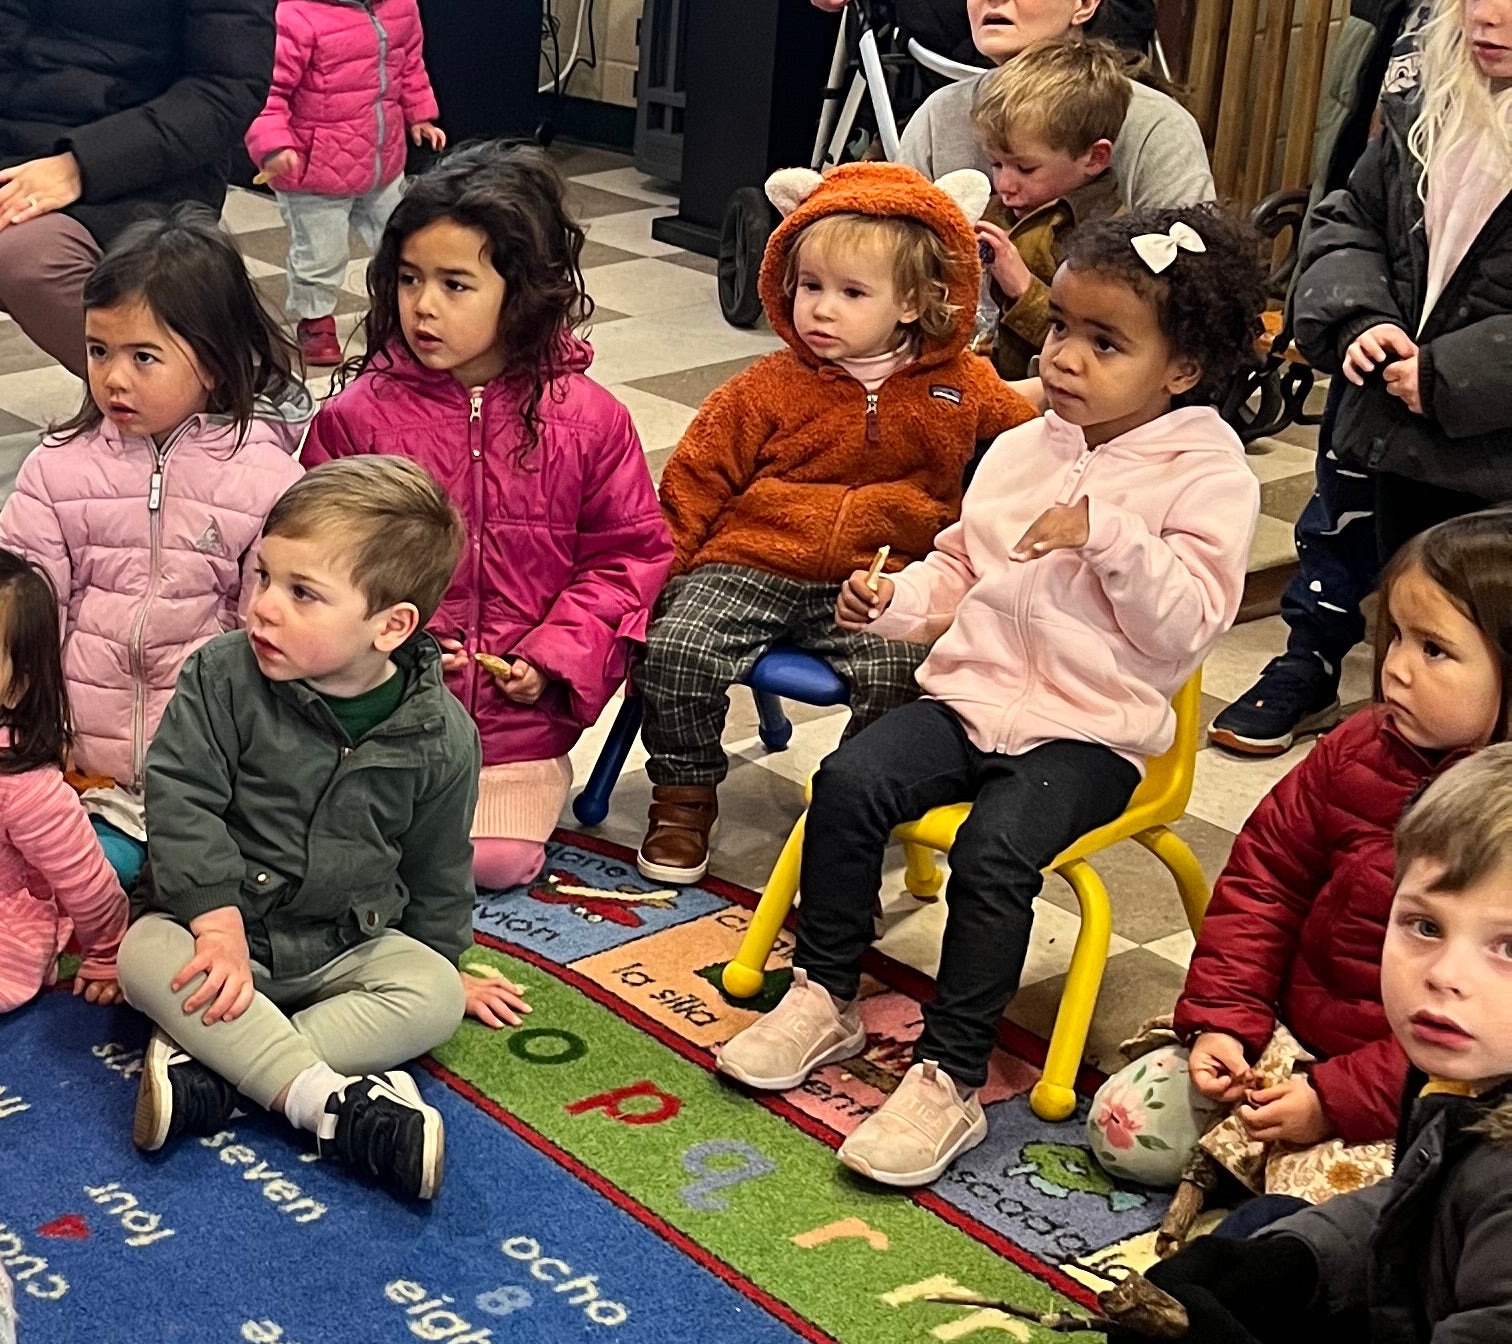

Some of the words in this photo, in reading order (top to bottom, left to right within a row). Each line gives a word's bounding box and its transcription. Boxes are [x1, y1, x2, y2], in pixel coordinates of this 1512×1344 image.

[545, 844, 628, 878] lane
[479, 905, 560, 942] vión
[649, 987, 720, 1026] silla
[564, 1079, 683, 1126] p
[200, 1131, 328, 1223] seven
[84, 1182, 175, 1246] four
[475, 1284, 533, 1316] 8
[500, 1235, 629, 1328] ocho
